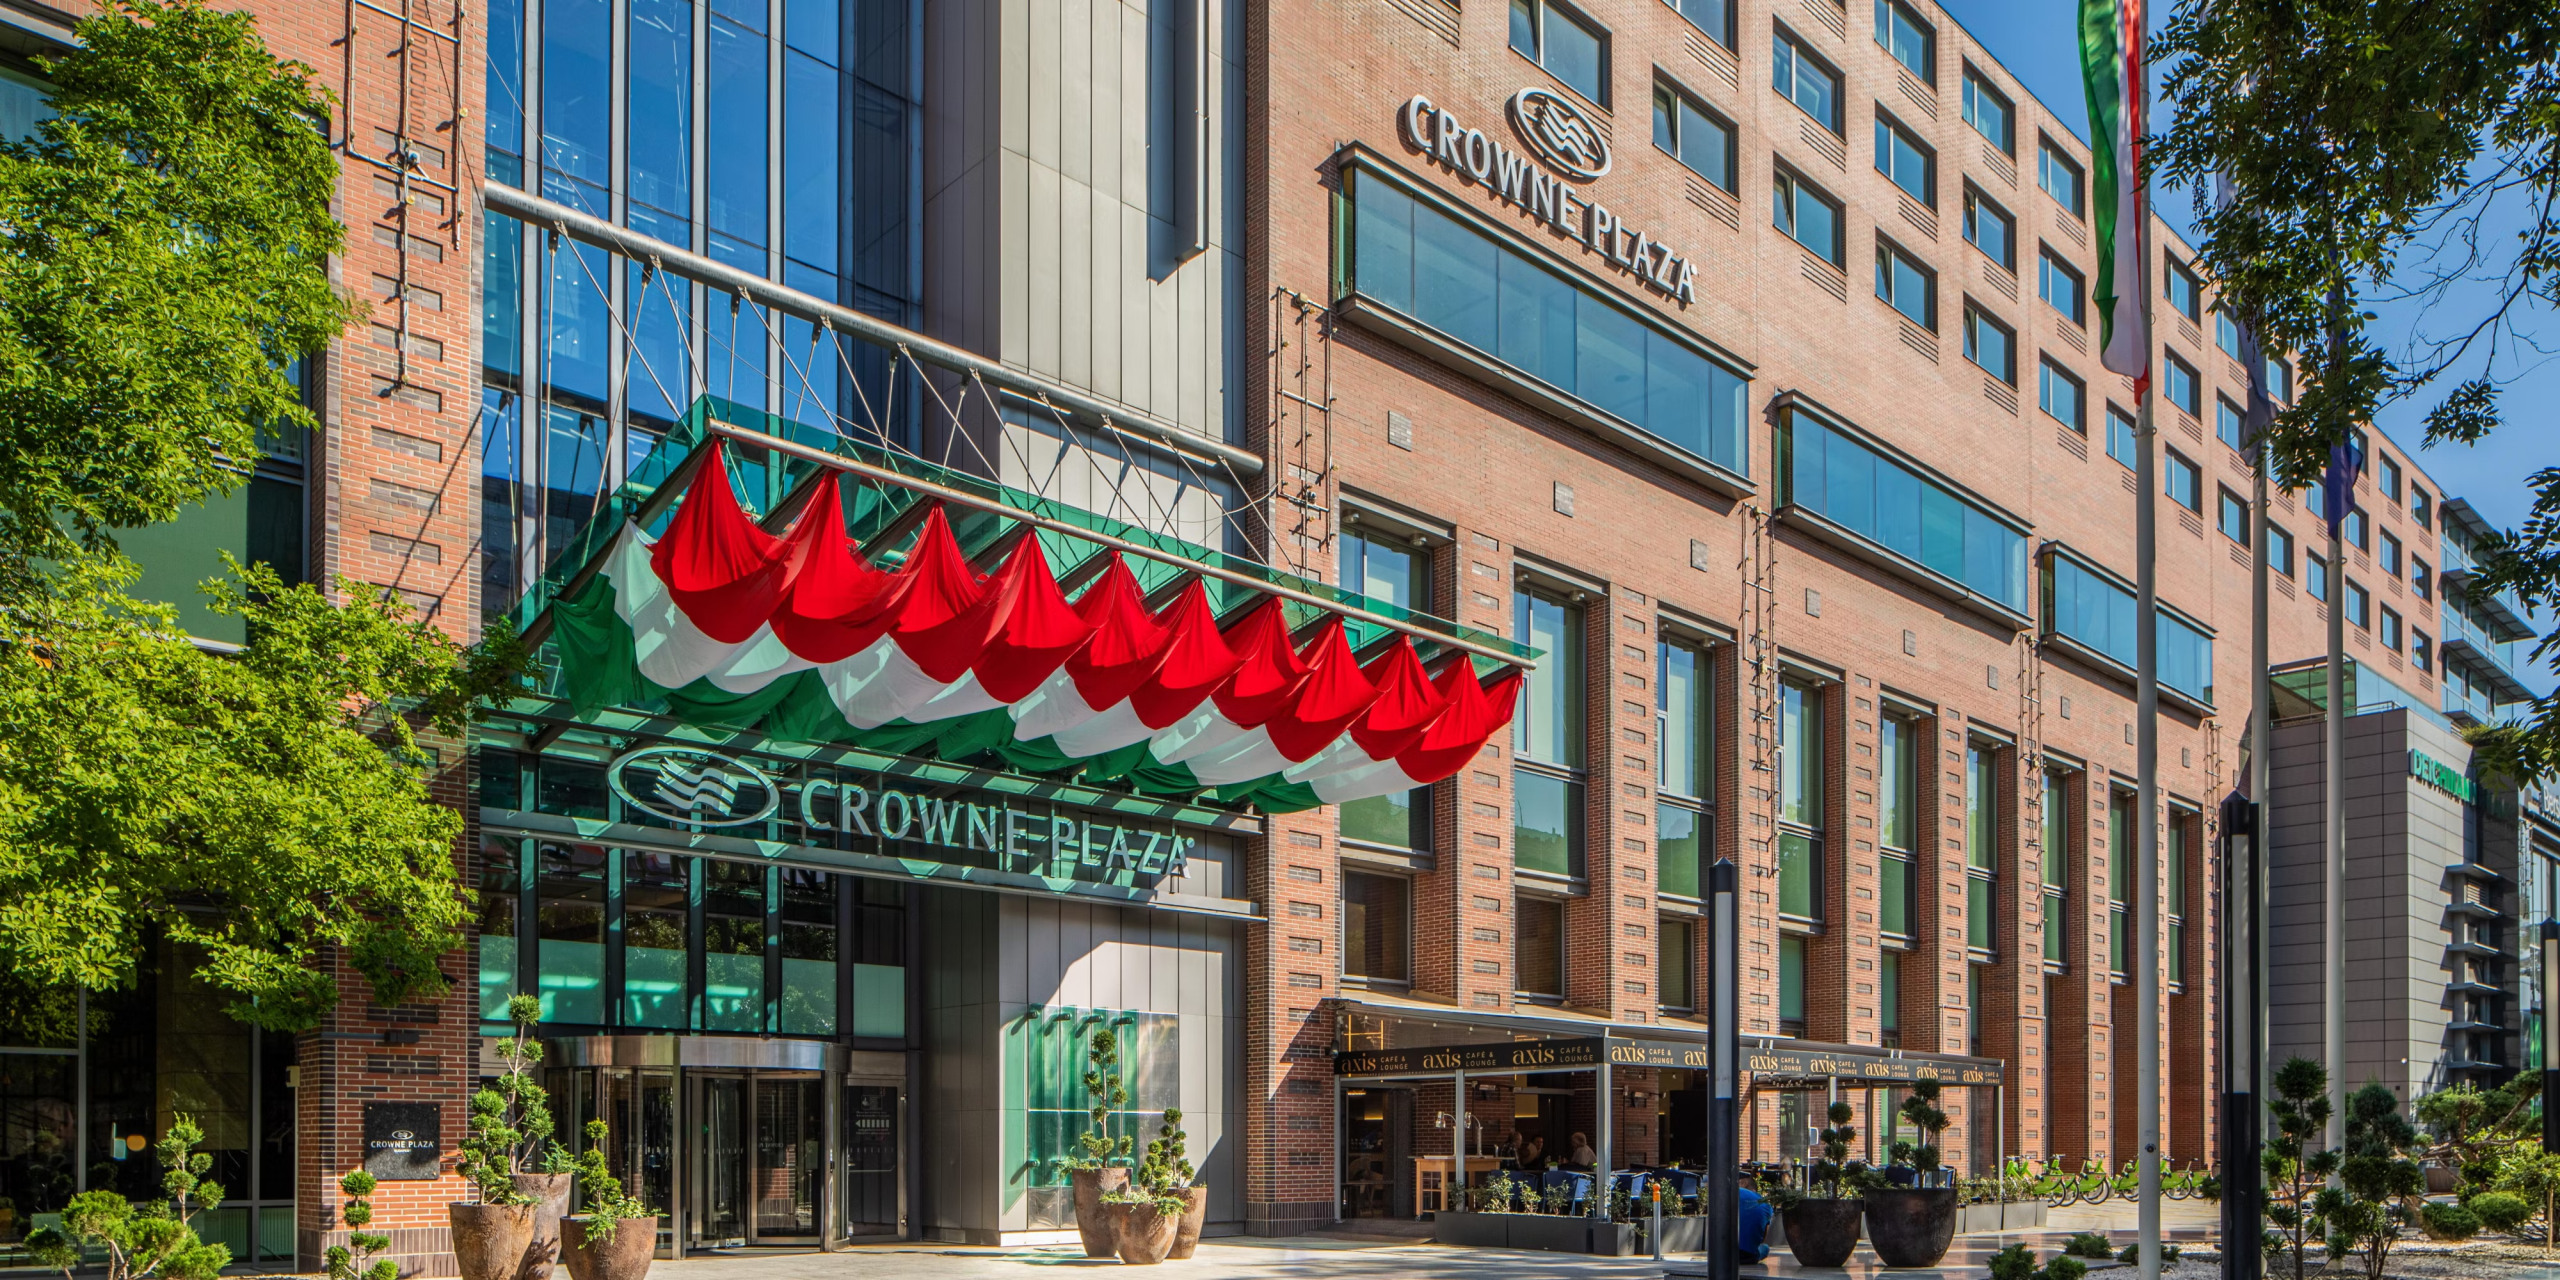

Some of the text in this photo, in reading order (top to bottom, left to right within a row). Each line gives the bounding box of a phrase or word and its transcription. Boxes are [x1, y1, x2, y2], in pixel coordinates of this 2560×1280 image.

[1406, 94, 1696, 304] CROWNE PLAZA
[2412, 748, 2477, 806] DEICHMANN
[800, 778, 1193, 879] CROWNE PLAZA
[1423, 1048, 1461, 1069] axis
[1465, 1051, 1487, 1059] CAFÉ
[1512, 1043, 1555, 1065] axis
[1560, 1046, 1582, 1054] CAFÉ
[1560, 1054, 1594, 1063] LOUNGE
[1611, 1041, 1646, 1063] axis
[1649, 1048, 1665, 1056] CAFÉ
[1684, 1046, 1708, 1066] axi
[1341, 1053, 1376, 1073] axis
[1380, 1063, 1408, 1071] LOUNGE
[1465, 1059, 1496, 1067] LOUNGE
[1750, 1051, 1778, 1070] axis
[1780, 1064, 1802, 1072] LOUNGE
[1810, 1055, 1836, 1074] axis
[1865, 1059, 1890, 1077] axis
[1916, 1063, 1938, 1080] axis
[1962, 1066, 1984, 1083] axis
[370, 1140, 434, 1148] CROWNE PLAZA
